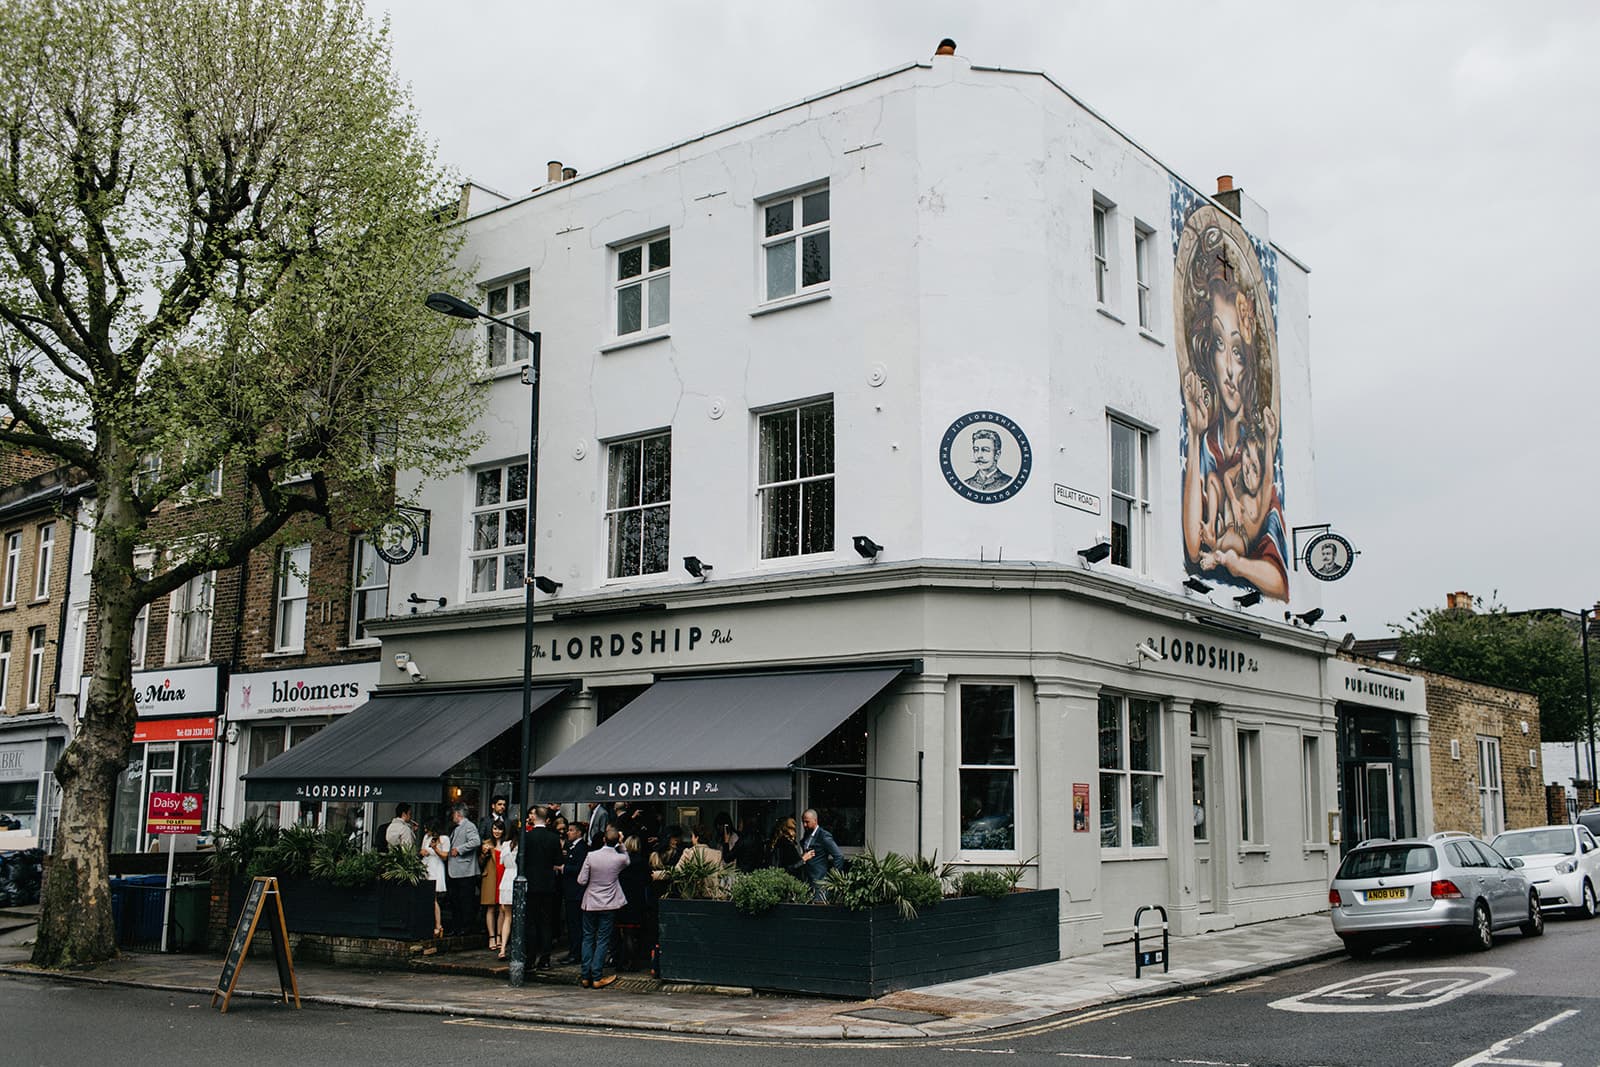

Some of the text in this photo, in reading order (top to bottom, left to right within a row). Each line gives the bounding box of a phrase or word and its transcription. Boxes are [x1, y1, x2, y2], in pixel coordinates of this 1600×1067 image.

[968, 413, 1016, 430] LORDSHIP
[1013, 468, 1028, 489] EAST
[966, 490, 1011, 502] DULWICH
[1056, 486, 1094, 506] PELLATT ROAD
[551, 626, 702, 662] LORDSHIP
[710, 628, 734, 645] Pub
[1161, 635, 1246, 674] LORDSHIP
[145, 679, 187, 704] Minx
[271, 680, 359, 703] bloomers
[1345, 676, 1362, 693] PUB
[1369, 681, 1405, 702] KITCHEN
[305, 784, 371, 797] LORDSHIP
[594, 780, 719, 797] The LORDSHIP Pub
[153, 797, 181, 811] Daisy
